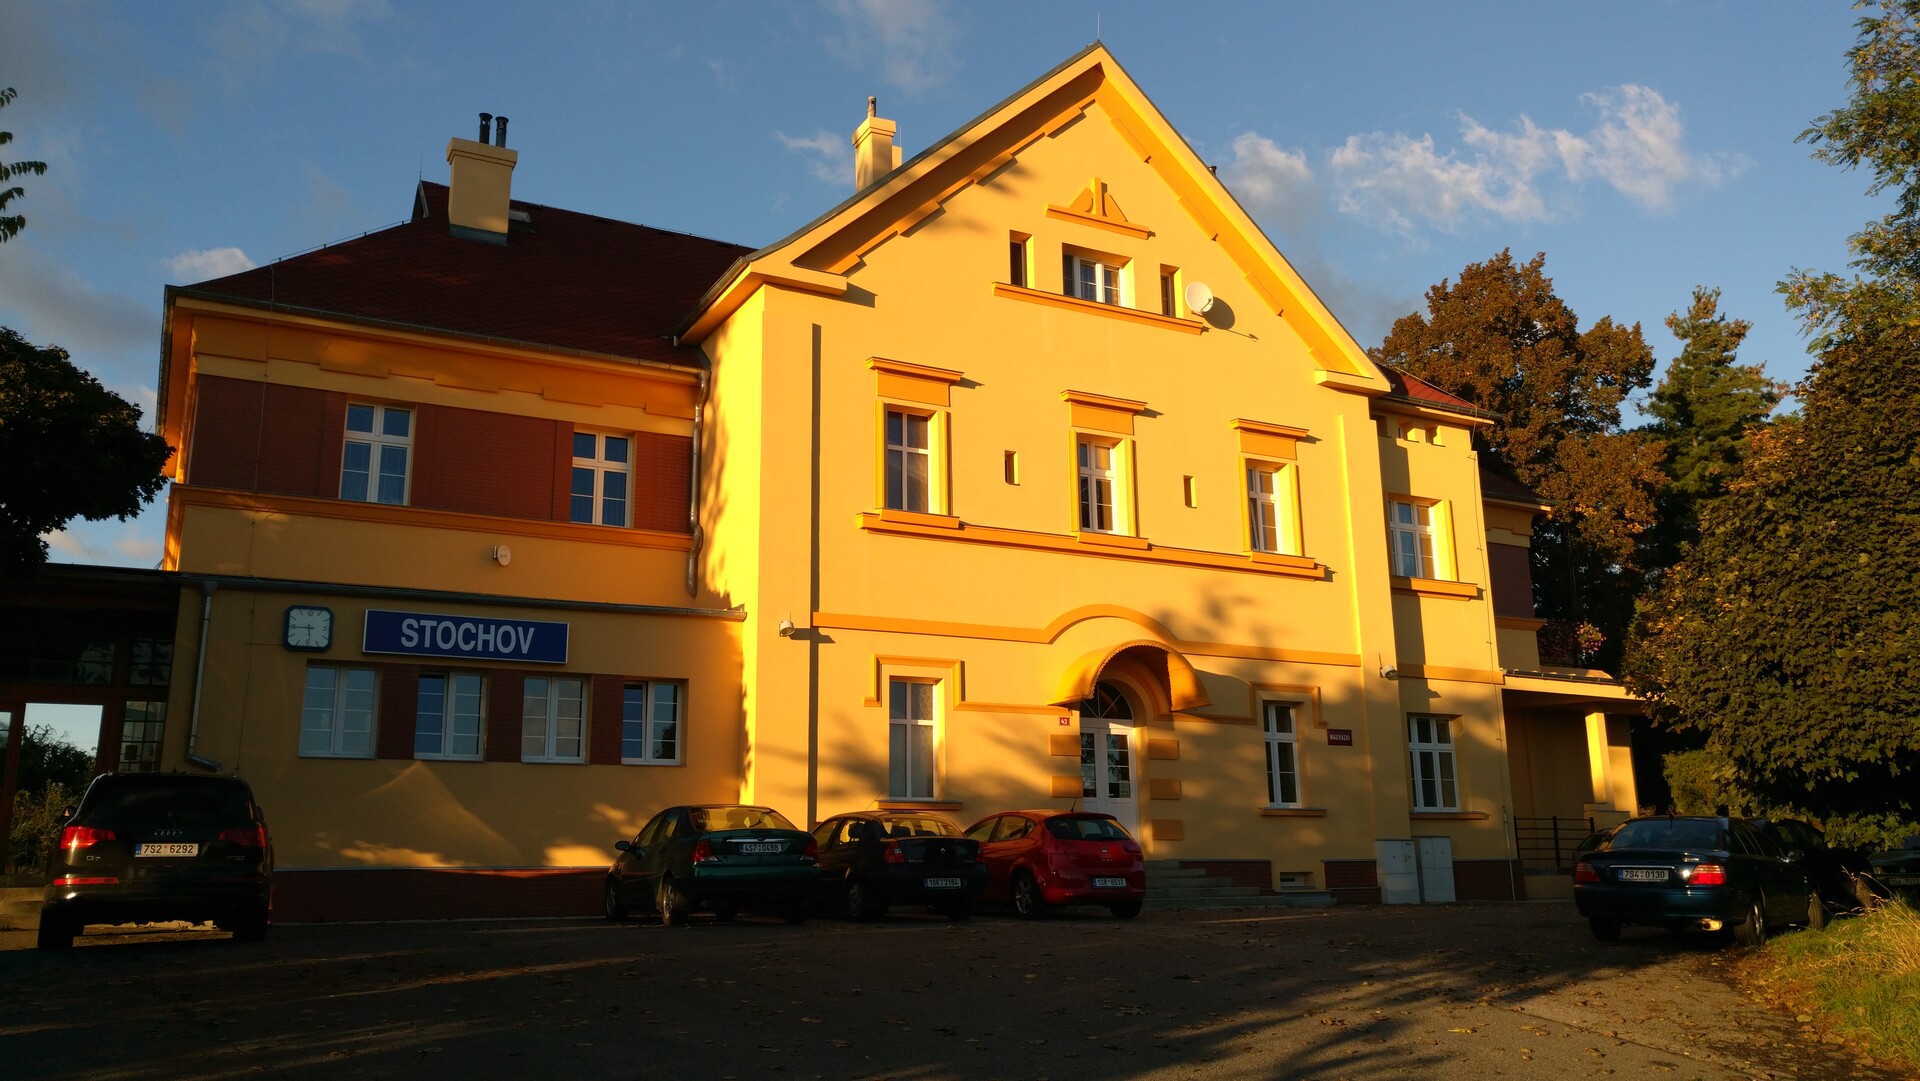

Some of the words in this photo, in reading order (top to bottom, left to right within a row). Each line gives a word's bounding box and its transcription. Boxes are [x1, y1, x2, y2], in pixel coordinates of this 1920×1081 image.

[400, 618, 535, 654] STOCHOV
[143, 844, 162, 854] 7S2
[169, 844, 194, 854] 6292
[745, 844, 757, 852] 4S7
[761, 844, 779, 852] 0488
[1624, 870, 1639, 878] 7S4
[1645, 870, 1665, 878] 0130
